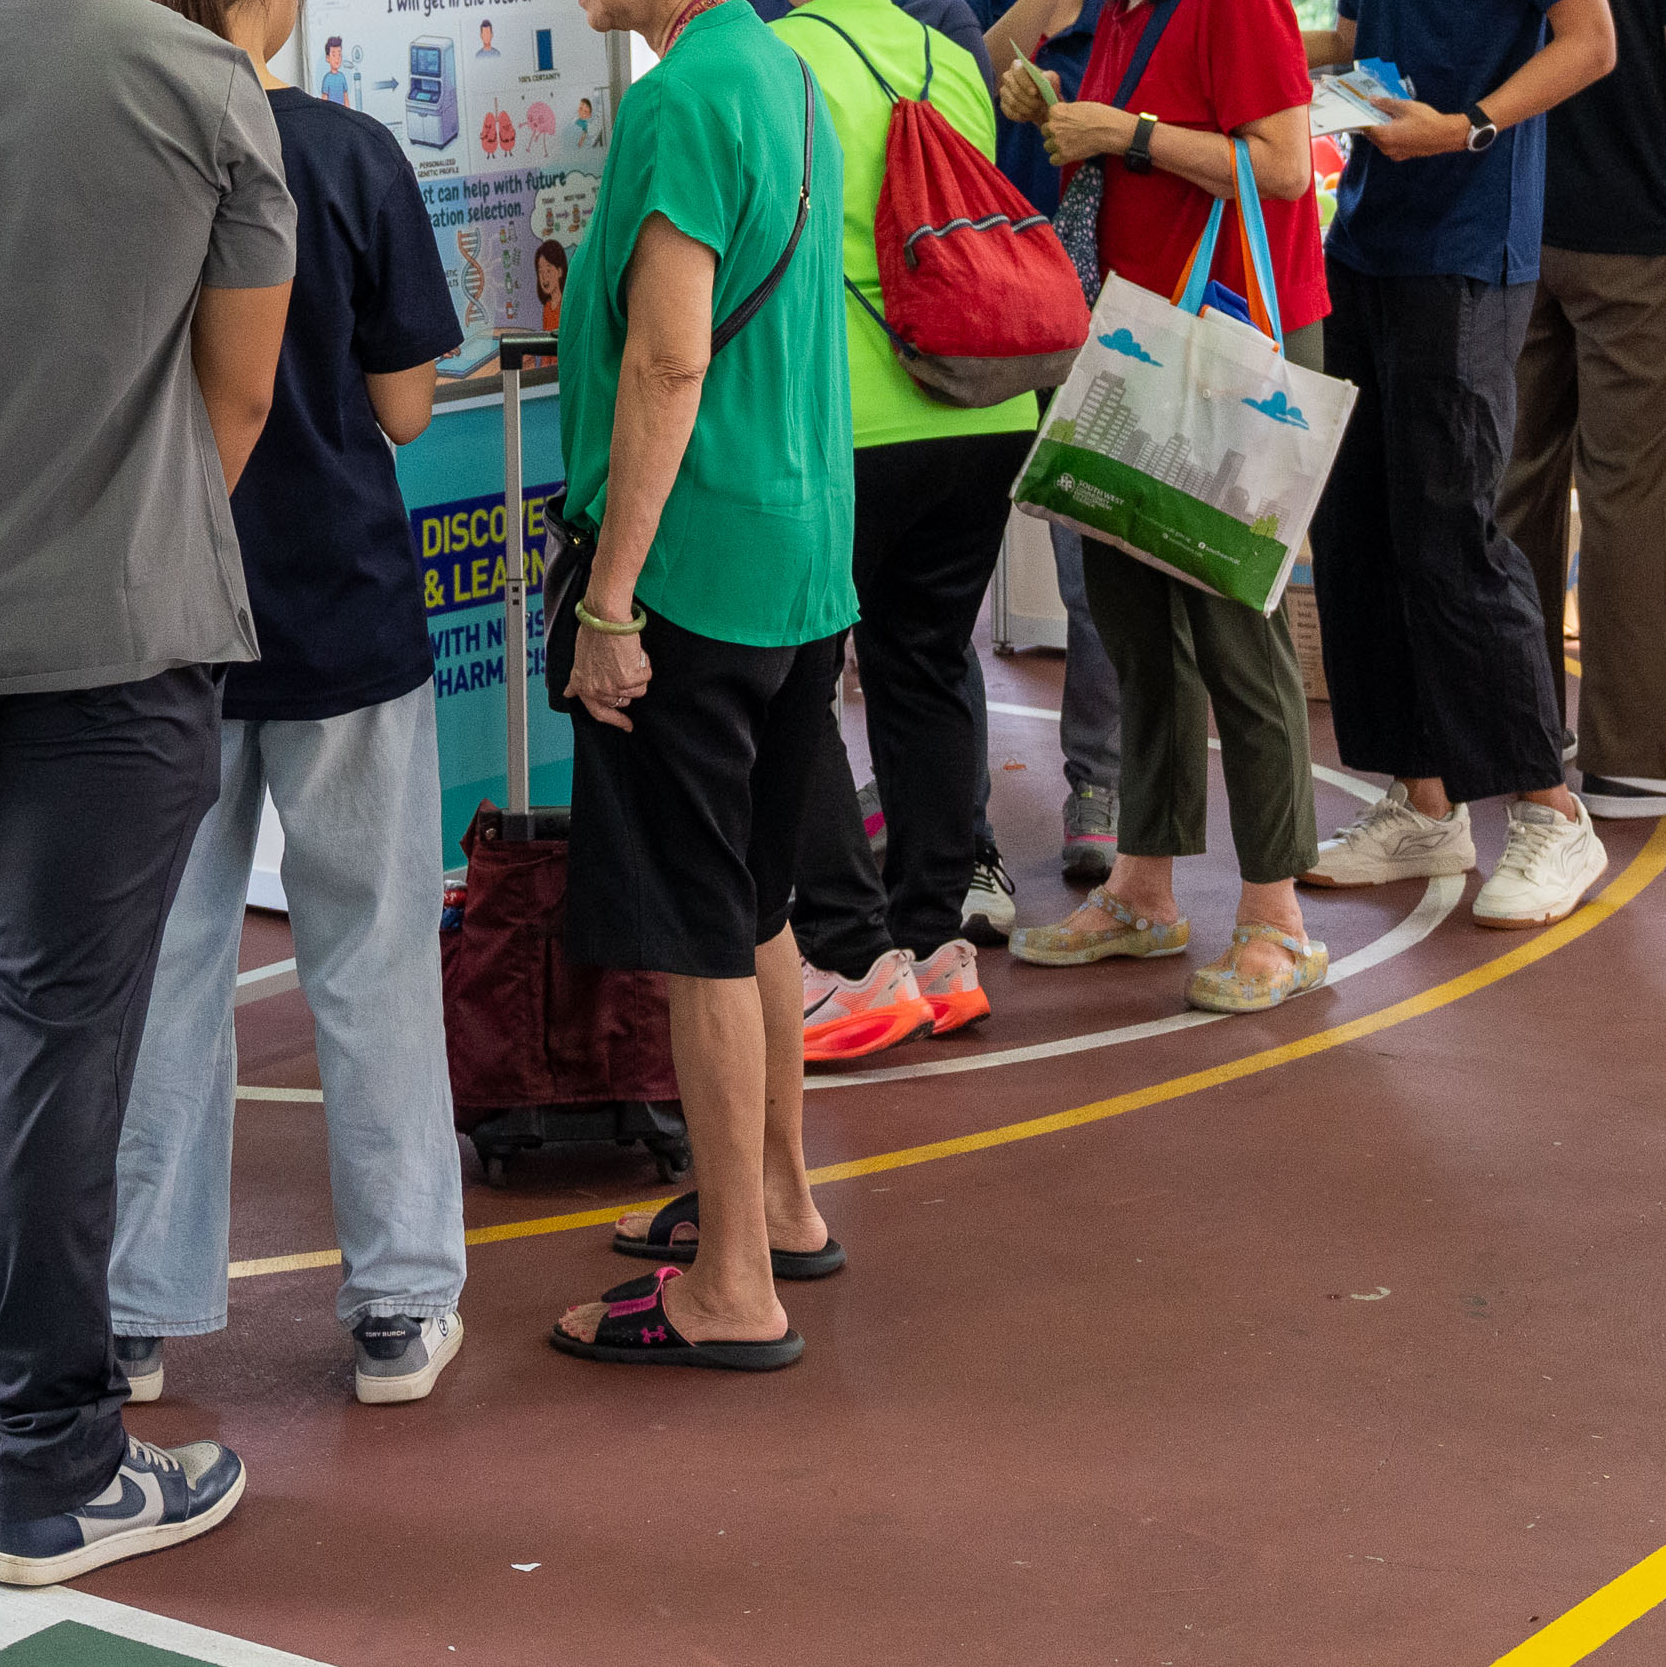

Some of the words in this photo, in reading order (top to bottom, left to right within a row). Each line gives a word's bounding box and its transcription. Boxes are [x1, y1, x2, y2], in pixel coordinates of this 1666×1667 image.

[438, 186, 459, 203] can
[463, 179, 490, 203] help
[494, 176, 522, 195] with
[525, 170, 567, 192] future
[430, 207, 464, 227] ation
[468, 200, 524, 223] selection.
[422, 494, 554, 558] DISCOE
[423, 568, 446, 608] &
[486, 607, 546, 648] NHS
